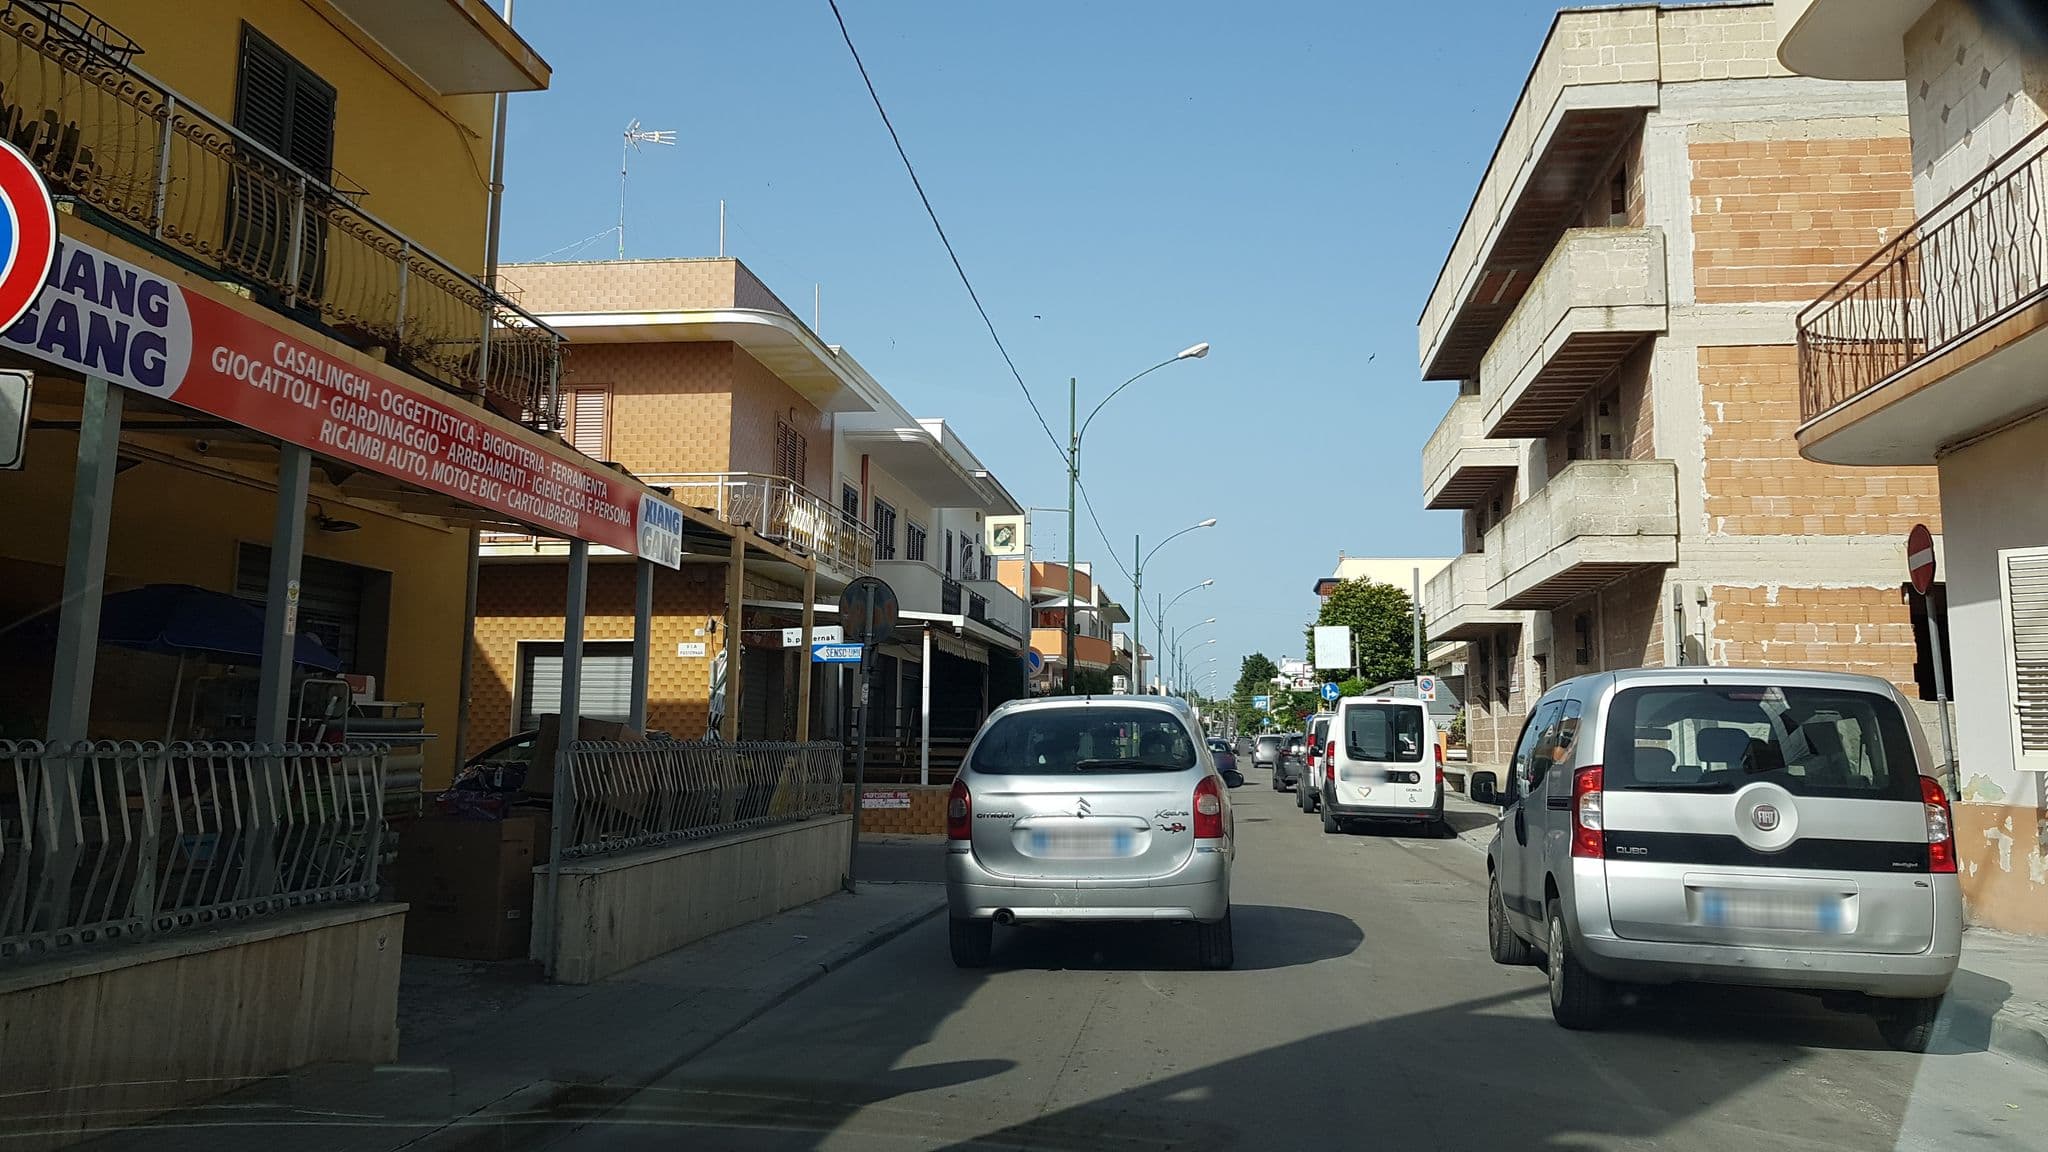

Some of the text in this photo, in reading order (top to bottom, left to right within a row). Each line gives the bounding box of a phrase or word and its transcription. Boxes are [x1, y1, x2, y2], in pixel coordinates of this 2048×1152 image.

[211, 346, 320, 410] GIOCATTOLI
[330, 396, 439, 455] GIARDINAGGIO
[447, 442, 526, 487] ARREDAMENTI
[532, 475, 563, 502] IGIENE
[563, 487, 586, 512] CASA
[587, 498, 594, 514] E
[594, 500, 631, 527] PERSONA
[273, 341, 370, 402] CASALINGHI
[380, 389, 474, 446] OGGETTISTICA
[482, 431, 544, 475] BIGIOTTERIA
[551, 461, 608, 499] FERRAMENTA
[319, 419, 386, 463] RICAMBI
[386, 445, 429, 480] AUTO,
[431, 460, 470, 491] MOTO
[470, 475, 479, 495] E
[479, 478, 502, 503] BICI
[507, 489, 579, 530] CARTOLIBRERIA
[644, 497, 680, 535] XIANG
[642, 526, 680, 566] GANG
[1757, 810, 1774, 824] FIAT
[1616, 846, 1648, 855] QUBO
